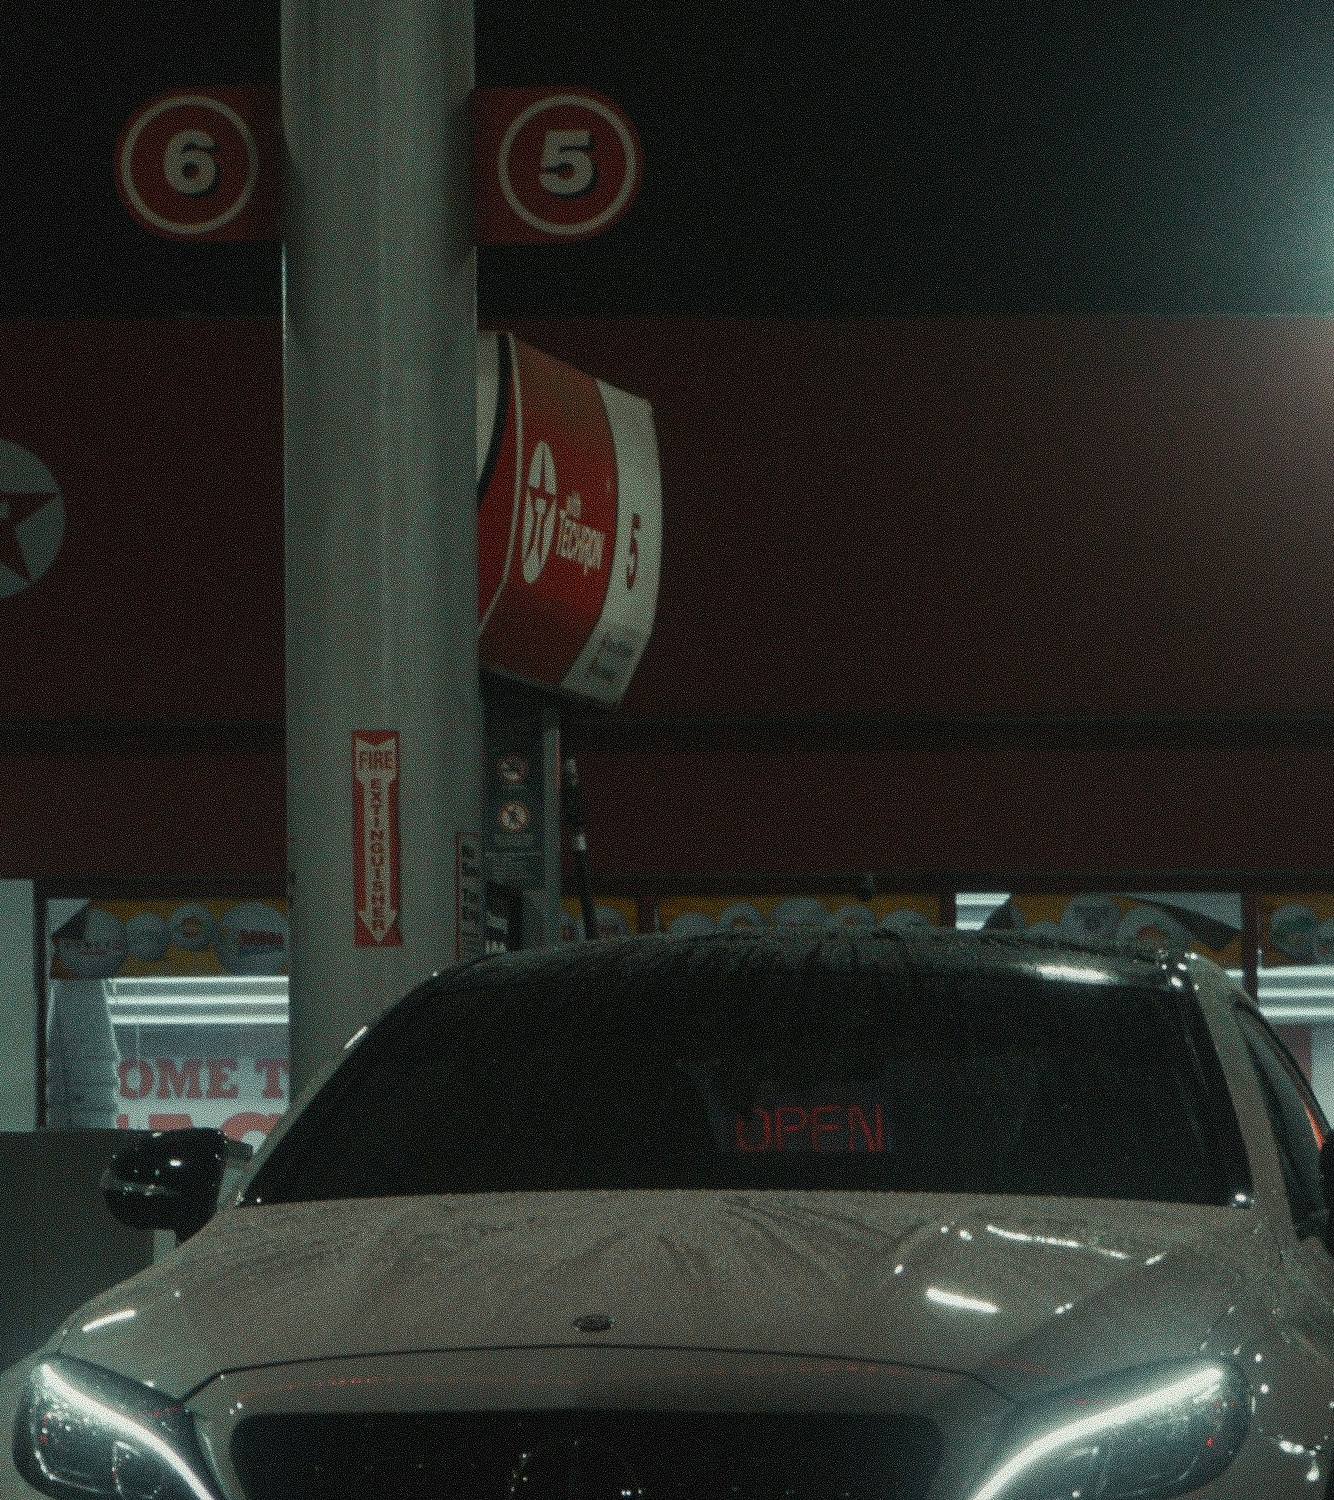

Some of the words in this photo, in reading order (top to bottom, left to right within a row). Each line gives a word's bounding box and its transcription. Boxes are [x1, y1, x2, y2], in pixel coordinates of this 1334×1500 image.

[162, 129, 220, 196] 6
[537, 130, 597, 196] 5
[626, 512, 642, 590] 5
[358, 750, 394, 770] FIRE
[370, 778, 385, 931] EXTINGUISHER
[117, 1057, 239, 1099] OME
[735, 1103, 885, 1153] OPEN
